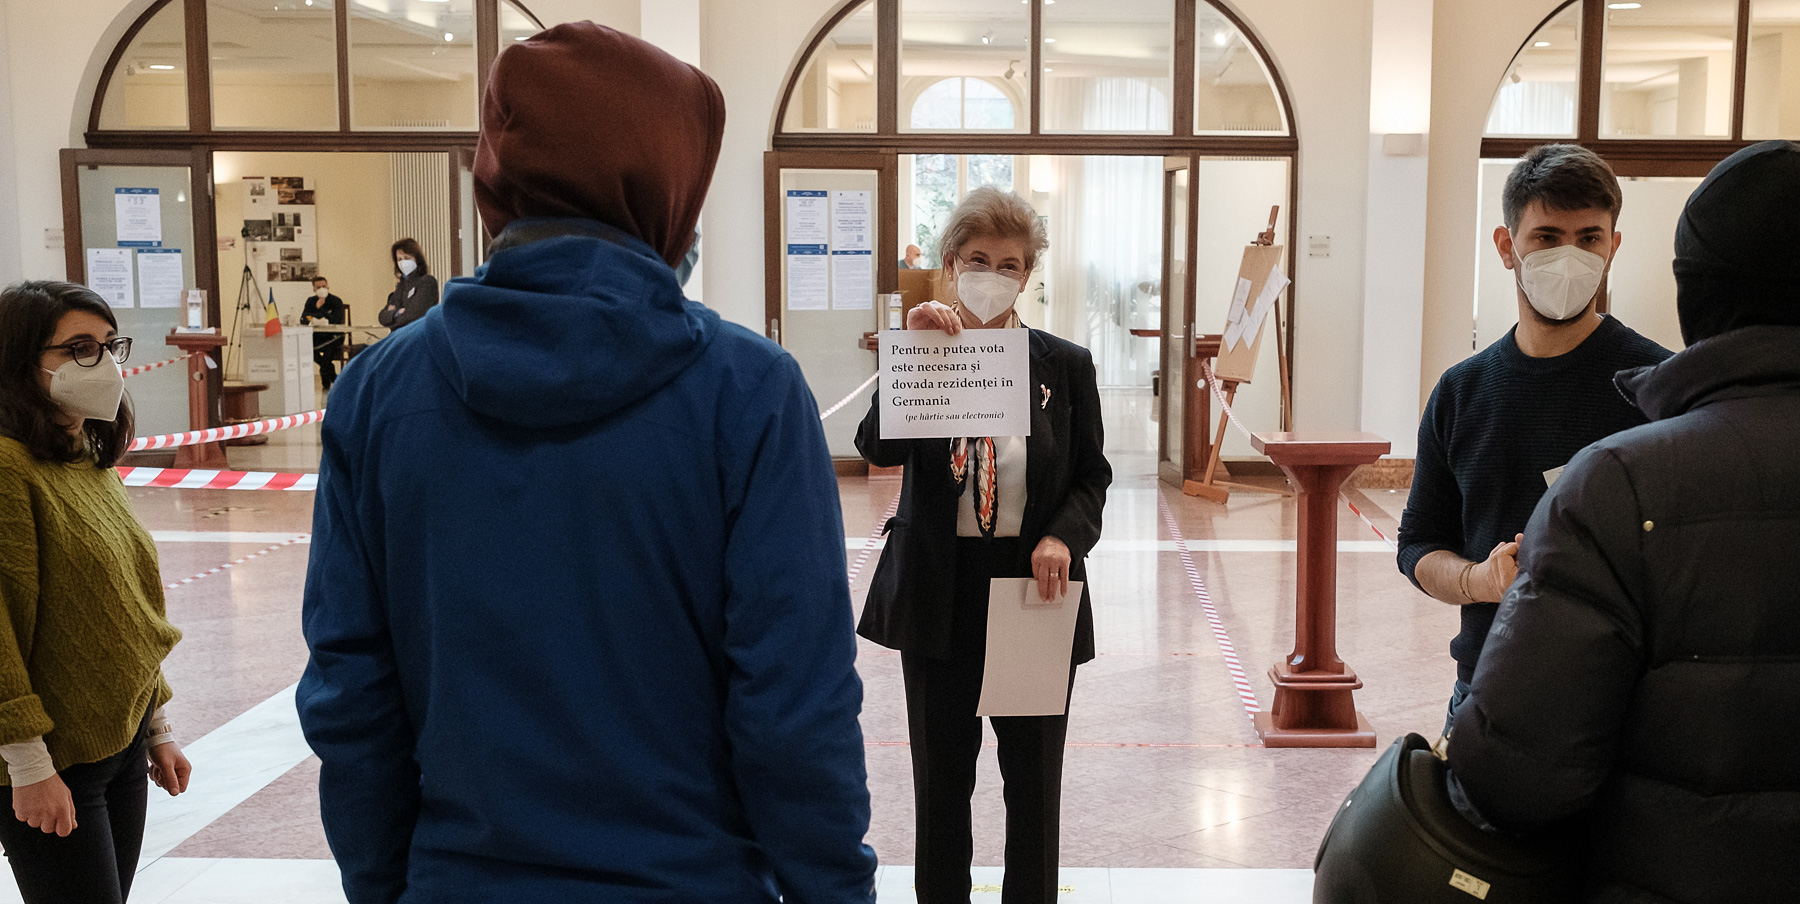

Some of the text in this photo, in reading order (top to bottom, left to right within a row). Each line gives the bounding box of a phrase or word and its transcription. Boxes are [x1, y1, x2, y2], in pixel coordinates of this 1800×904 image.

[891, 343, 1005, 357] Pentru a putea vota
[891, 363, 914, 372] este
[917, 363, 967, 372] necesara
[892, 379, 934, 390] dovada
[1001, 377, 1014, 388] în
[892, 395, 951, 407] Germania
[905, 413, 918, 423] (pe
[919, 412, 944, 421] hârtie
[961, 411, 1005, 421] electronic)
